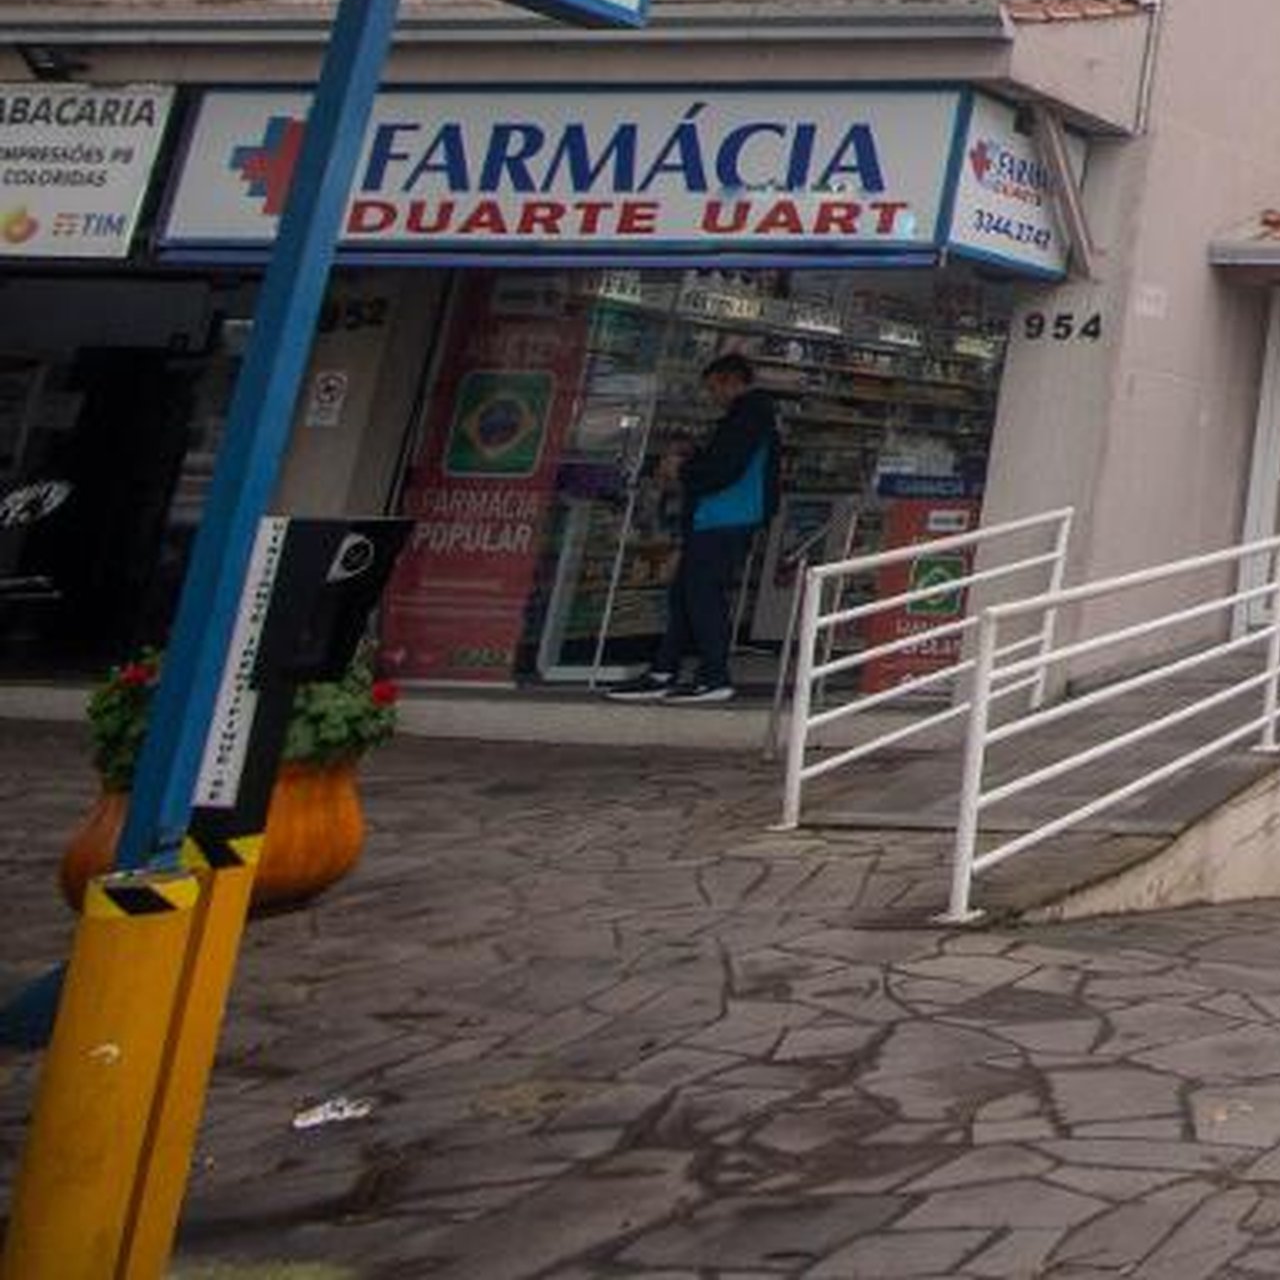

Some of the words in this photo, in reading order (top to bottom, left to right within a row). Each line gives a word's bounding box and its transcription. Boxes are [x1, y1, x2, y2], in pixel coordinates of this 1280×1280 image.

[360, 102, 886, 194] FARMÁCIA
[83, 213, 127, 236] TIM
[347, 201, 661, 235] DUARTE
[700, 201, 908, 235] UART
[1024, 311, 1102, 340] 954
[411, 521, 534, 555] POPULAR
